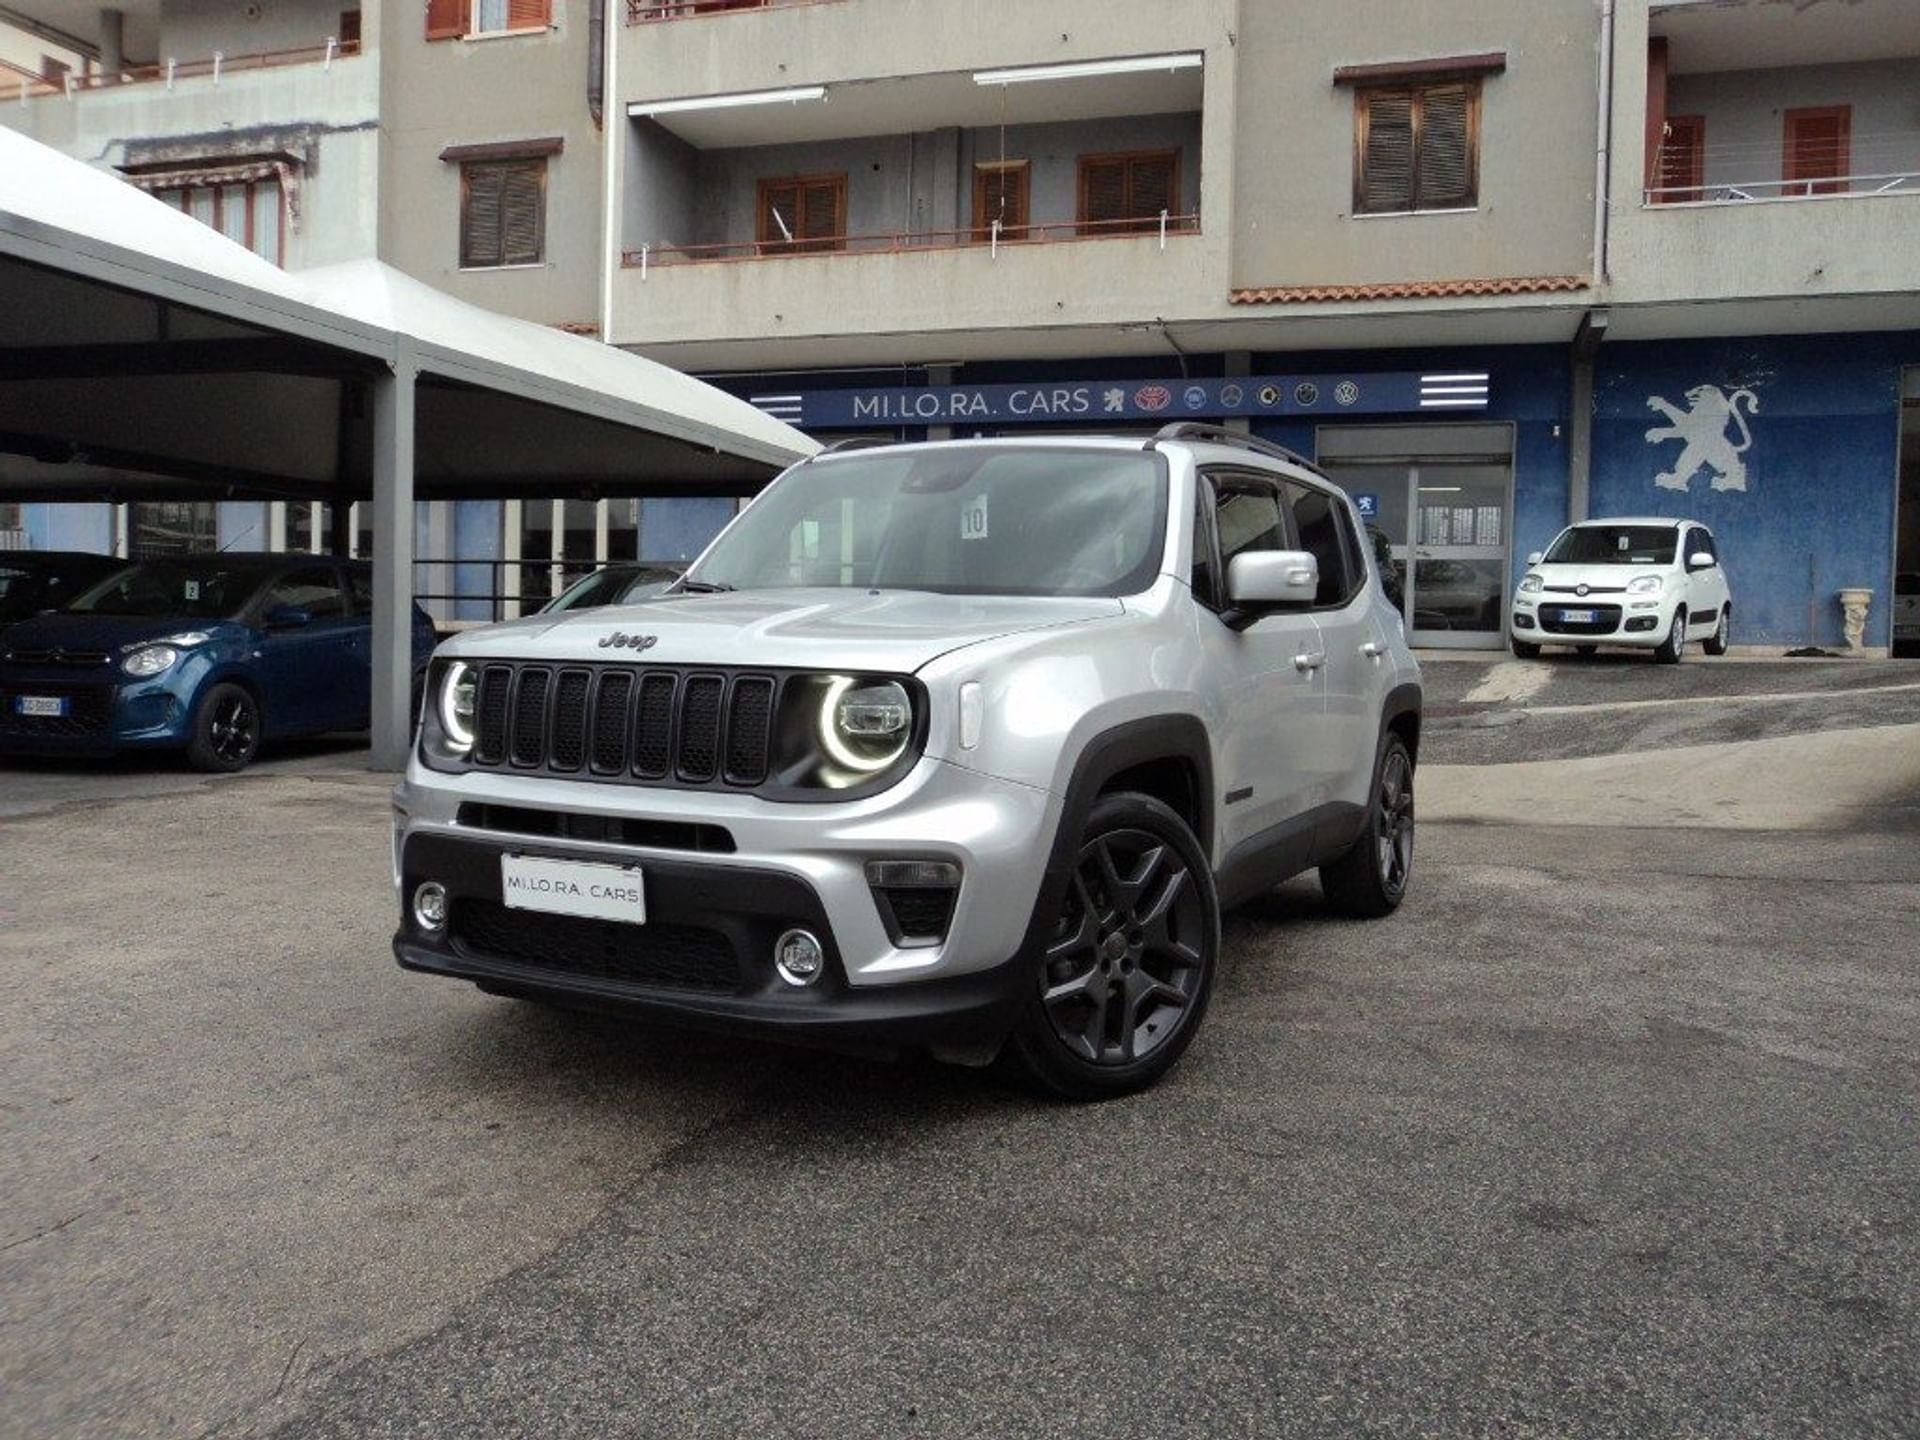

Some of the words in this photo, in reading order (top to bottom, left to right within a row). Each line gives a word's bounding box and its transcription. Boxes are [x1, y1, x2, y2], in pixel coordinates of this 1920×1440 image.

[853, 392, 998, 418] MI.LO.RA.
[1008, 388, 1090, 414] CARS
[963, 508, 984, 533] 10
[598, 631, 658, 652] Jeep
[590, 884, 640, 904] CARS
